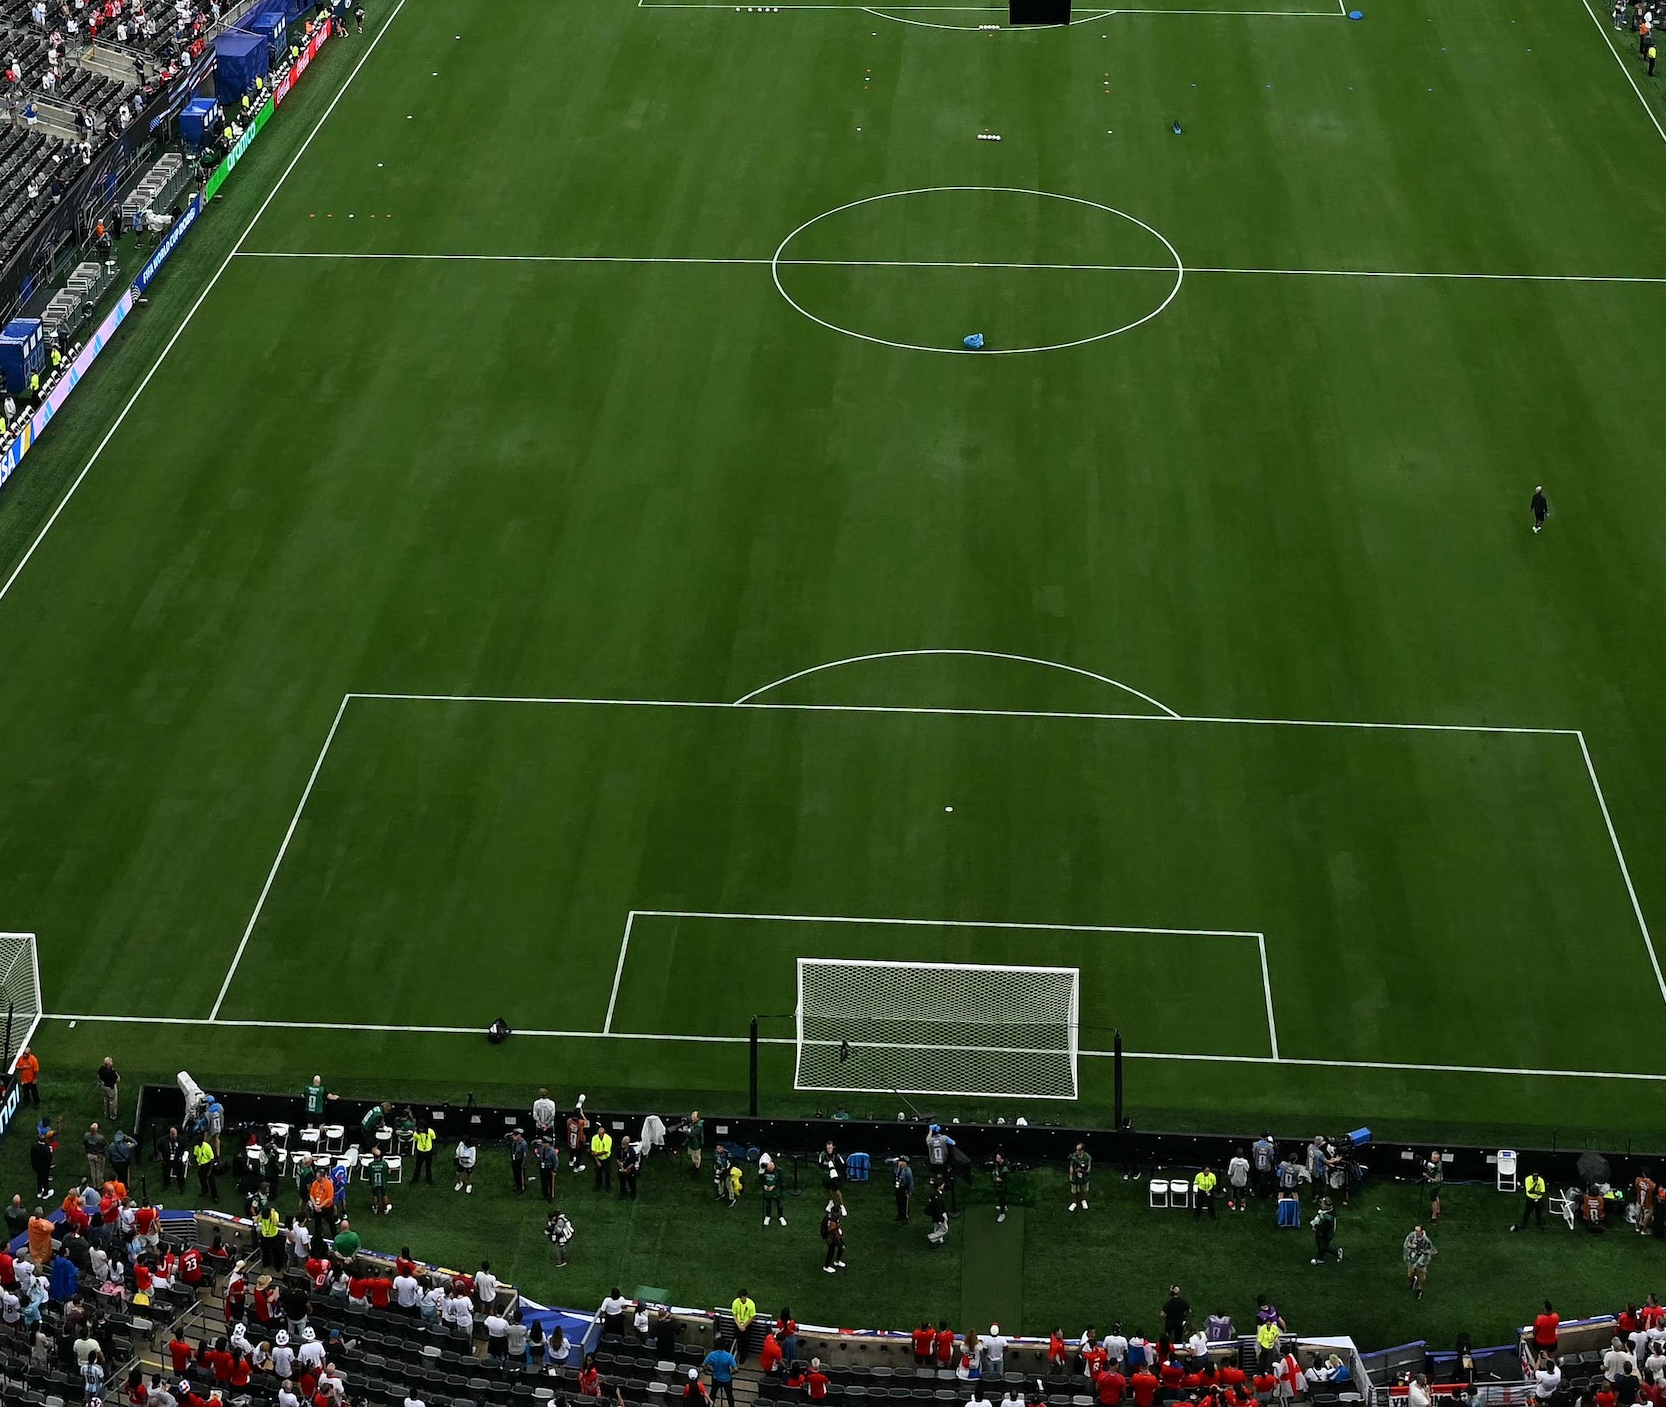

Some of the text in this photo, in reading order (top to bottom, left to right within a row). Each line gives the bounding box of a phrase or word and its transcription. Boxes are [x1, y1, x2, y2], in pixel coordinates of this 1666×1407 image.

[226, 122, 257, 172] aramco
[142, 262, 155, 285] FIFA
[153, 241, 171, 268] WORLD
[169, 228, 182, 248] CUP
[186, 1256, 197, 1270] 23
[4, 1304, 13, 1314] 18
[86, 1374, 95, 1385] 10
